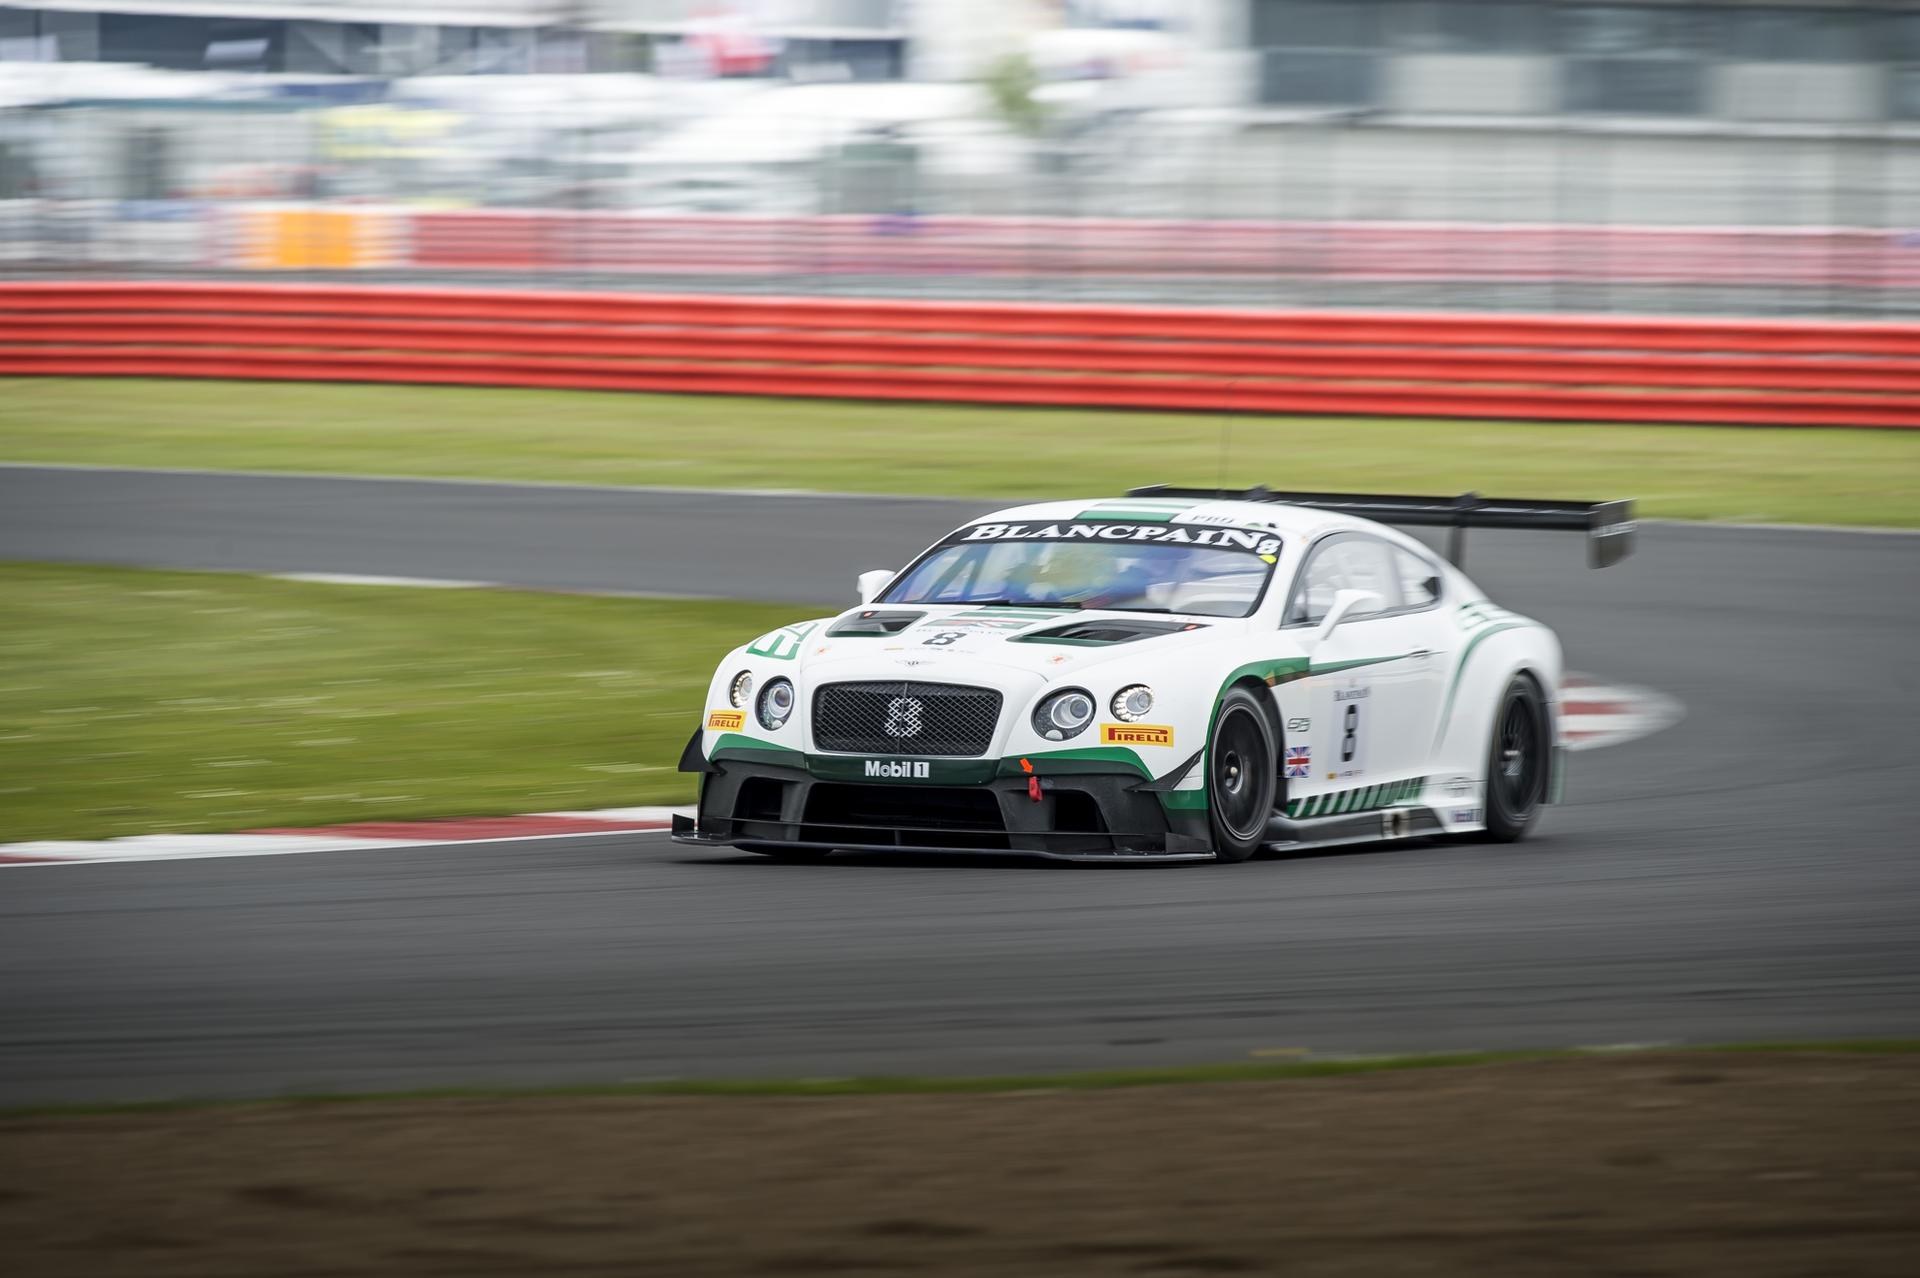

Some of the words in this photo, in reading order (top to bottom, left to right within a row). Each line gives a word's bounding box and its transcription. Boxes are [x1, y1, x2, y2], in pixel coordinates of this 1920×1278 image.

[960, 524, 1268, 549] BLANCPAIN
[1256, 539, 1282, 555] 8
[922, 632, 967, 645] 8
[708, 714, 742, 728] PIRELLI
[884, 697, 923, 737] 8
[1108, 728, 1168, 743] PIRELLI
[1341, 704, 1359, 762] 8
[865, 760, 911, 778] Mobil
[914, 761, 930, 778] 1
